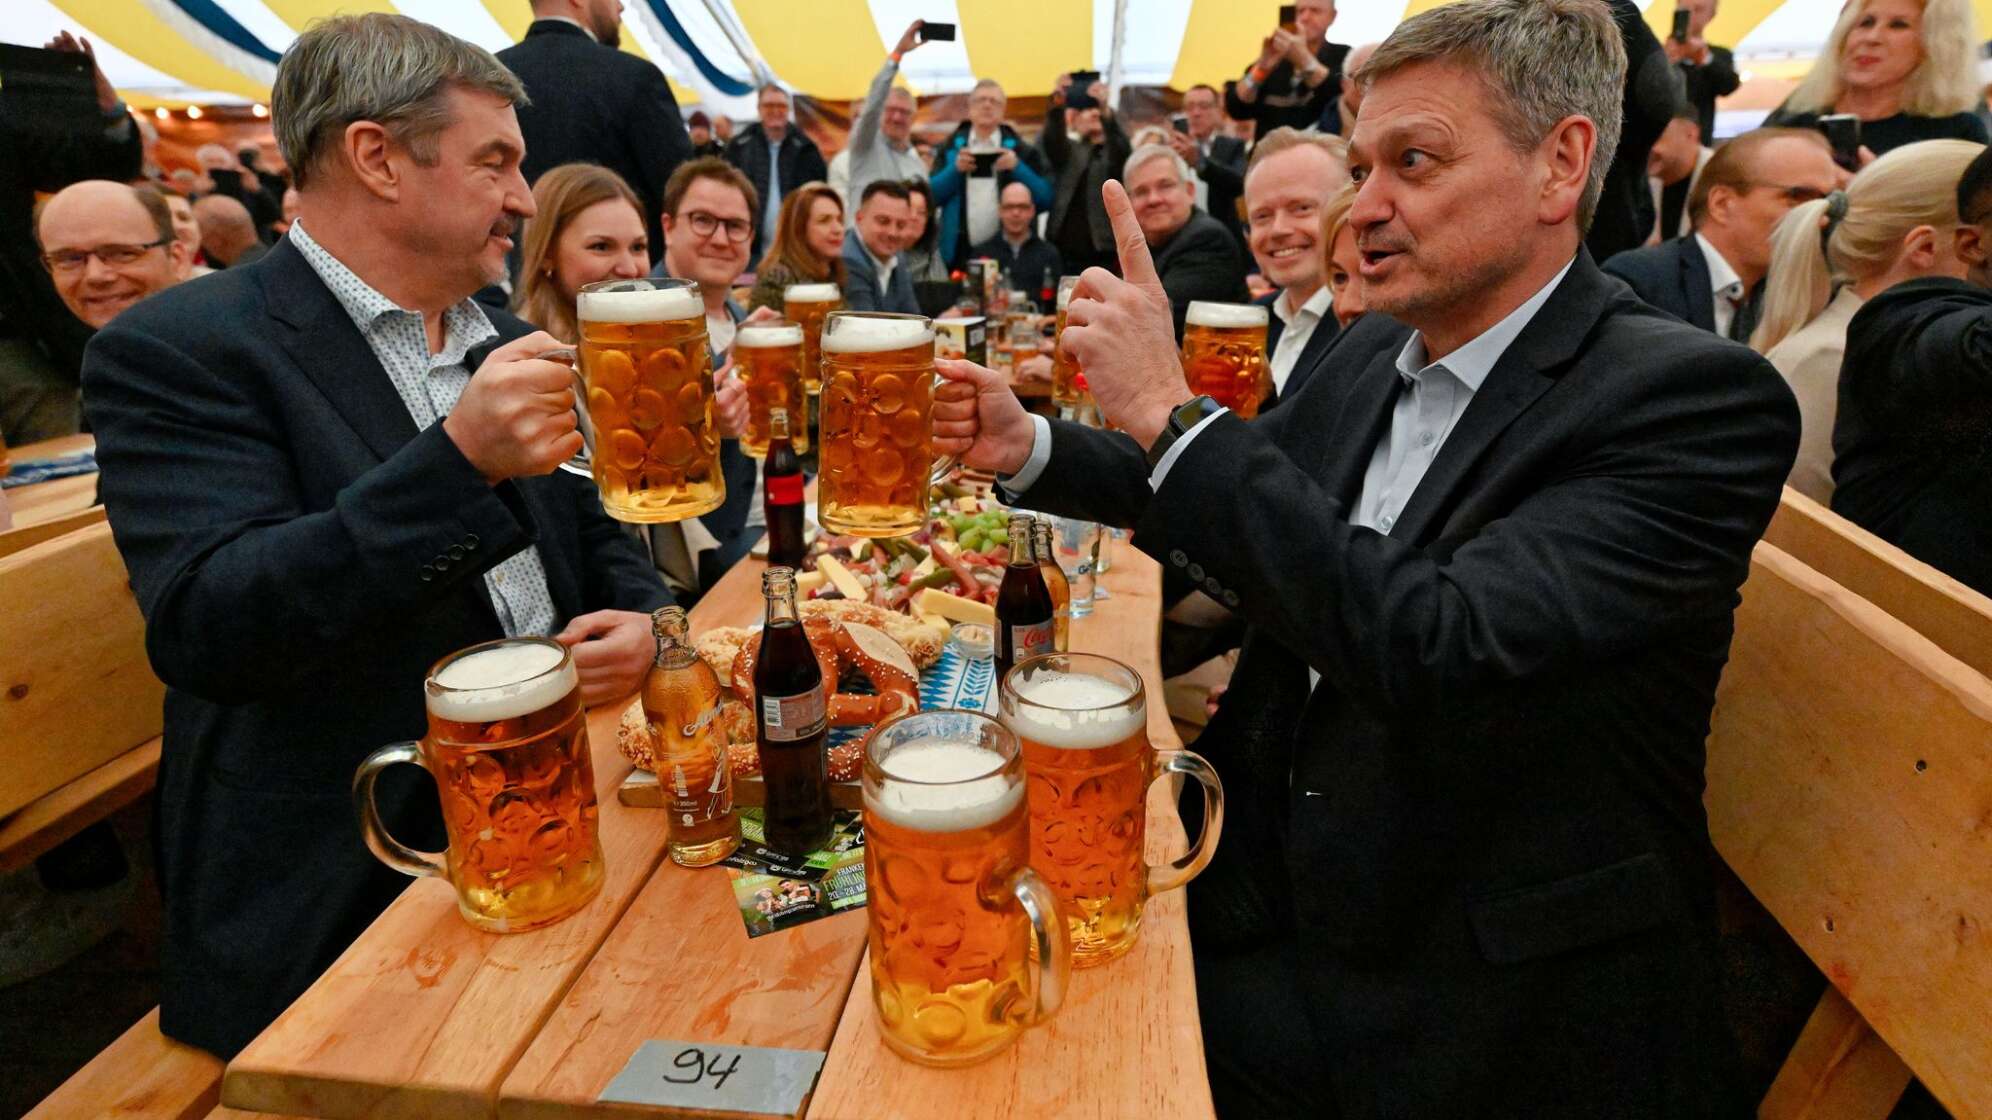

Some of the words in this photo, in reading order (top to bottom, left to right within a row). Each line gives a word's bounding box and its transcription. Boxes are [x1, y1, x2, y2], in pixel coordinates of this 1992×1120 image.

[837, 863, 865, 875] FRANKE
[823, 870, 866, 891] FRÜHLIN
[663, 1048, 742, 1090] 94
